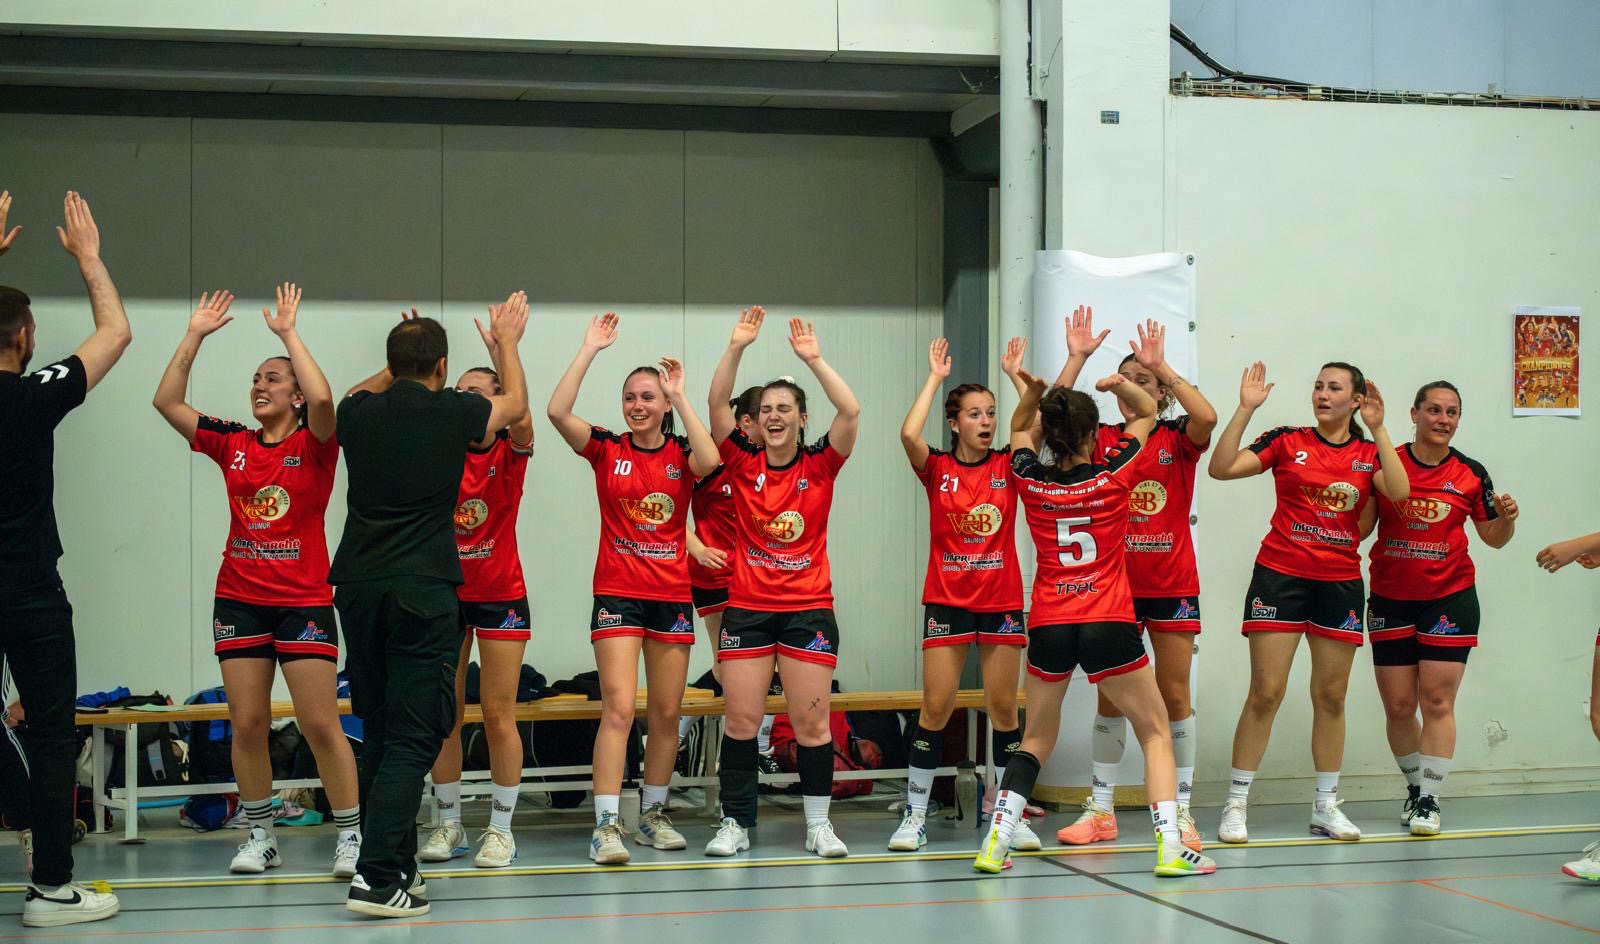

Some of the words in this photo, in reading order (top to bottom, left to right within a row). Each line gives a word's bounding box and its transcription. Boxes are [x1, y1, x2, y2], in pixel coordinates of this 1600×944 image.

[1294, 450, 1309, 466] 2
[613, 459, 632, 476] 10
[755, 473, 767, 492] 9
[940, 474, 959, 492] 21
[619, 497, 664, 521] V&B
[1128, 491, 1157, 512] &B
[947, 513, 992, 535] V&B
[1056, 517, 1098, 567] 5
[1056, 581, 1098, 595] TPPL
[1252, 607, 1277, 618] USDH
